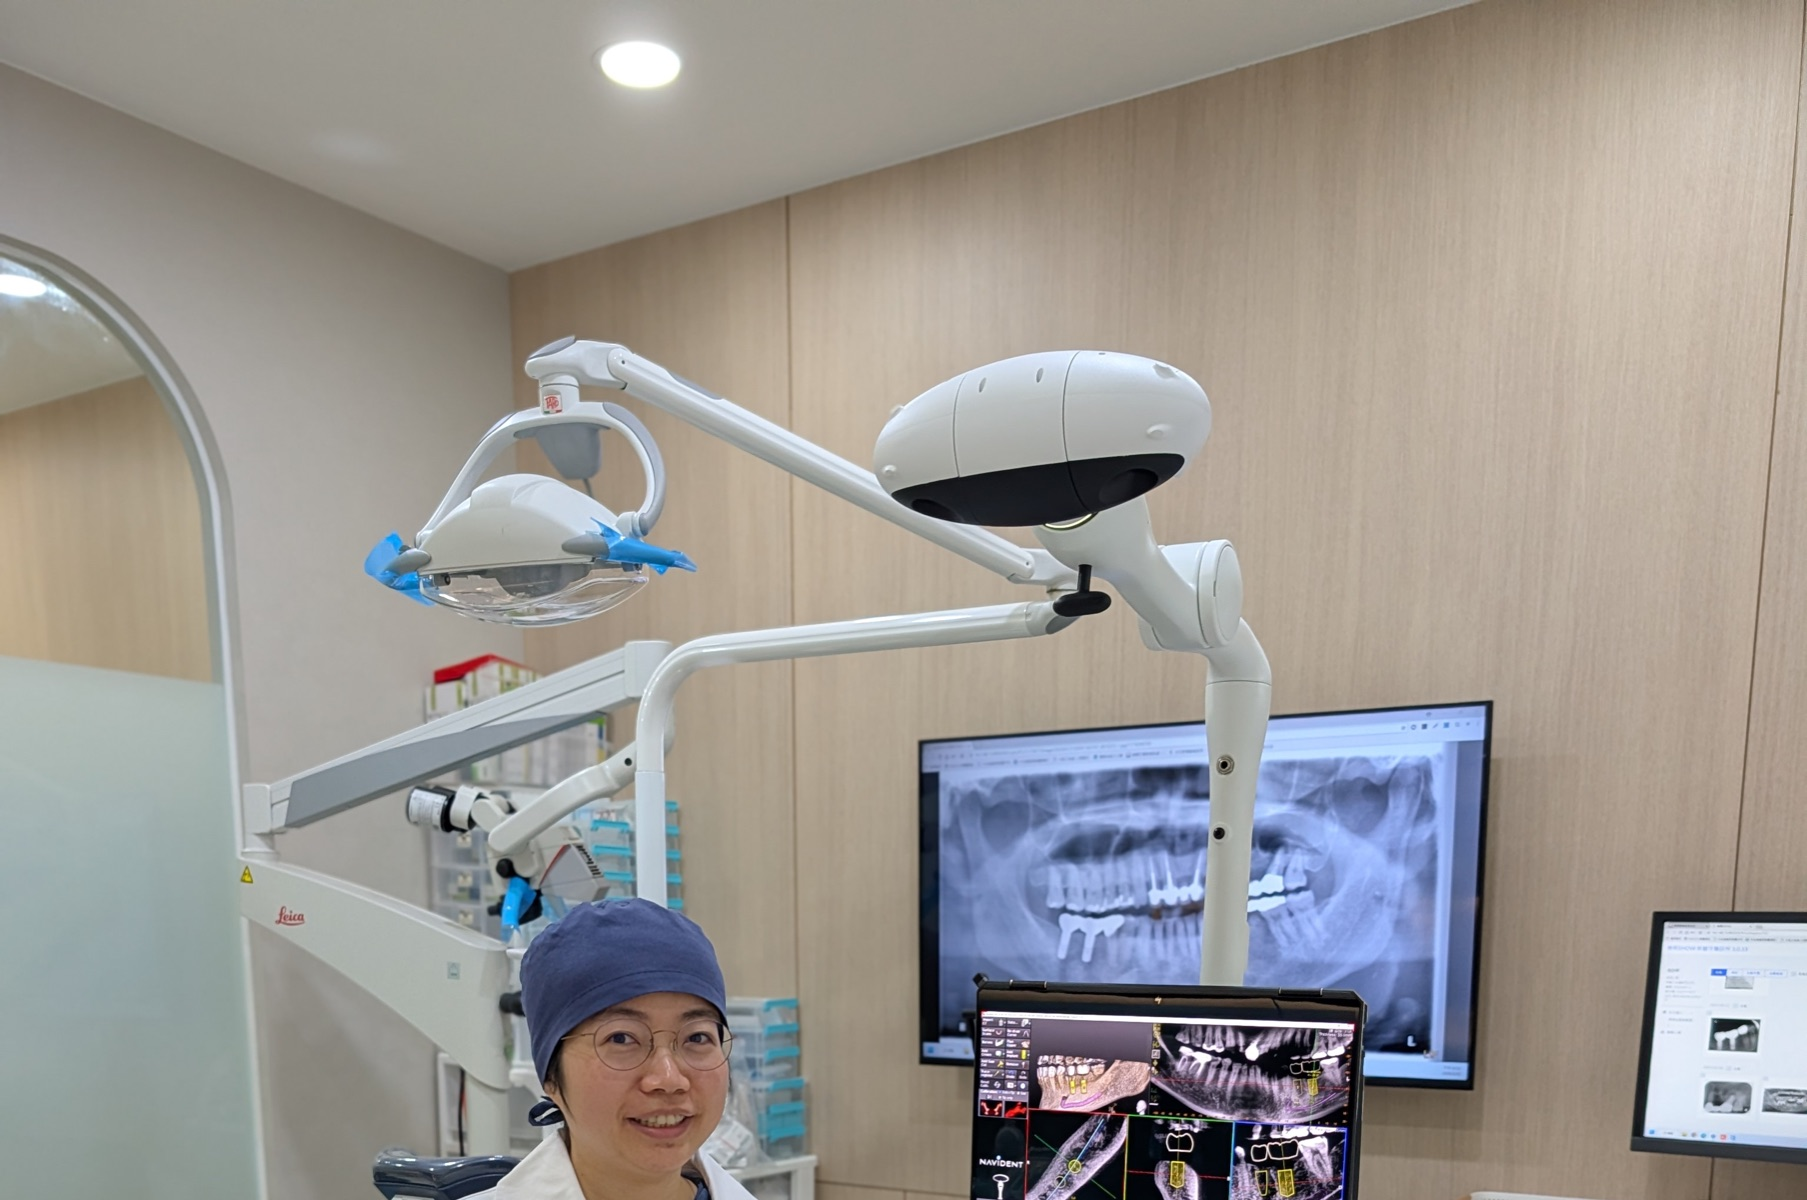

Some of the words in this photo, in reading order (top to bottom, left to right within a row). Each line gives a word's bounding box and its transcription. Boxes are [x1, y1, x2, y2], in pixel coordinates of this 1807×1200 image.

[275, 905, 306, 927] Leica
[1407, 1035, 1417, 1047] L
[979, 1158, 1024, 1168] NAVIDENT
